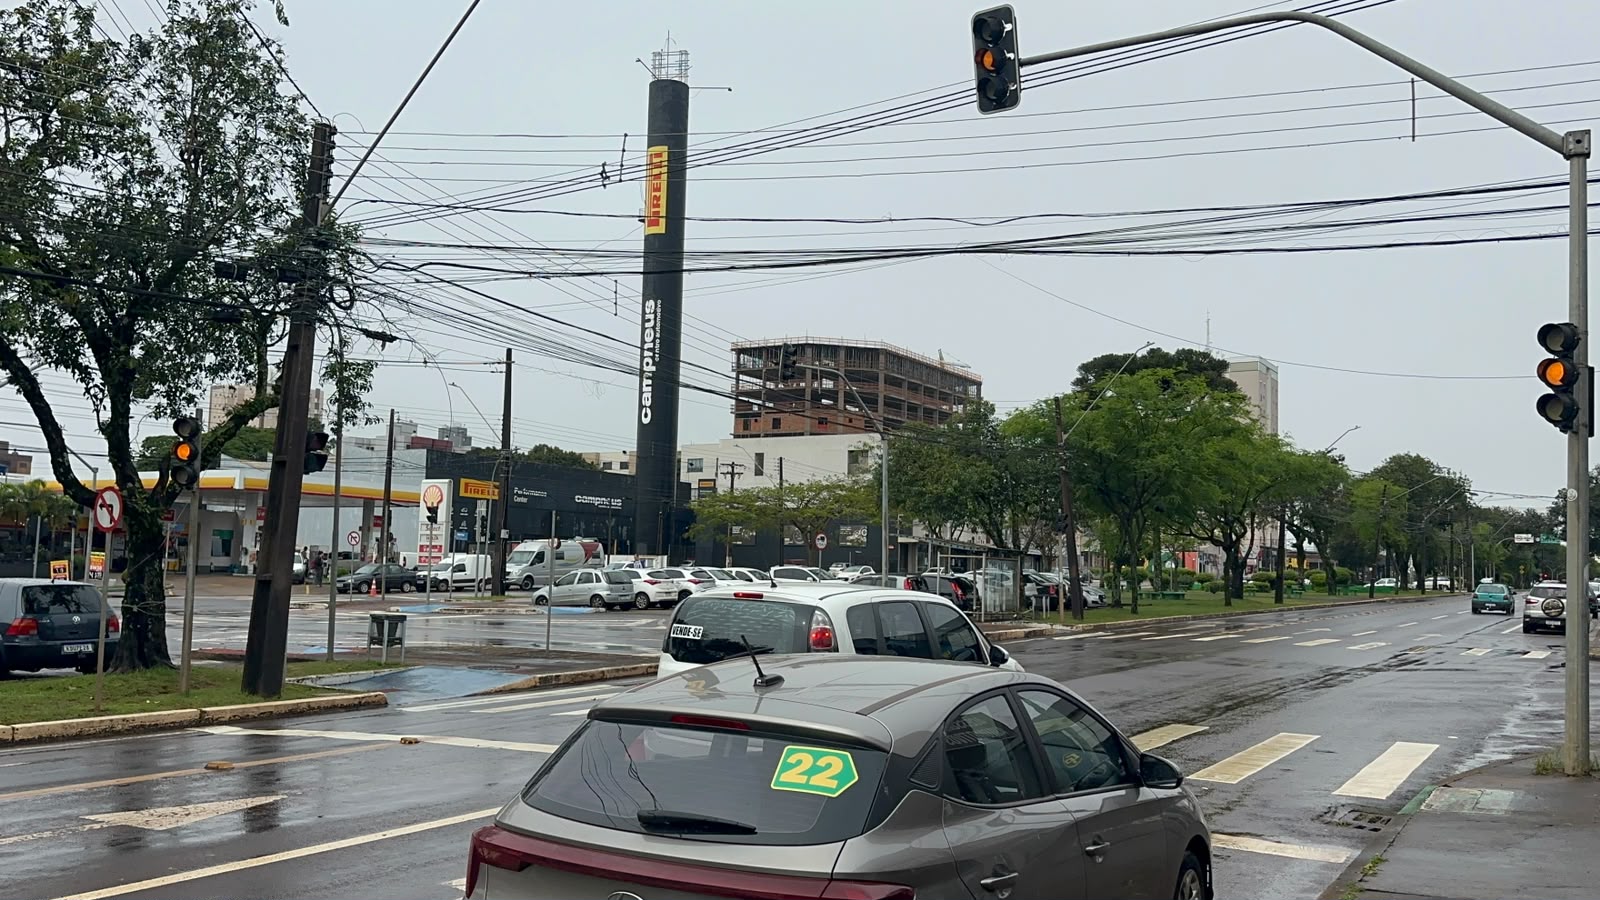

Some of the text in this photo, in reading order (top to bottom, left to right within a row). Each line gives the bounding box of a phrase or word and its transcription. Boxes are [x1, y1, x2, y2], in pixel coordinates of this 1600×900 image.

[647, 152, 663, 227] PIRELLI
[641, 300, 656, 424] campneus
[464, 482, 499, 497] PIRELL
[673, 626, 702, 638] VENDE-SE
[779, 752, 844, 789] 22
